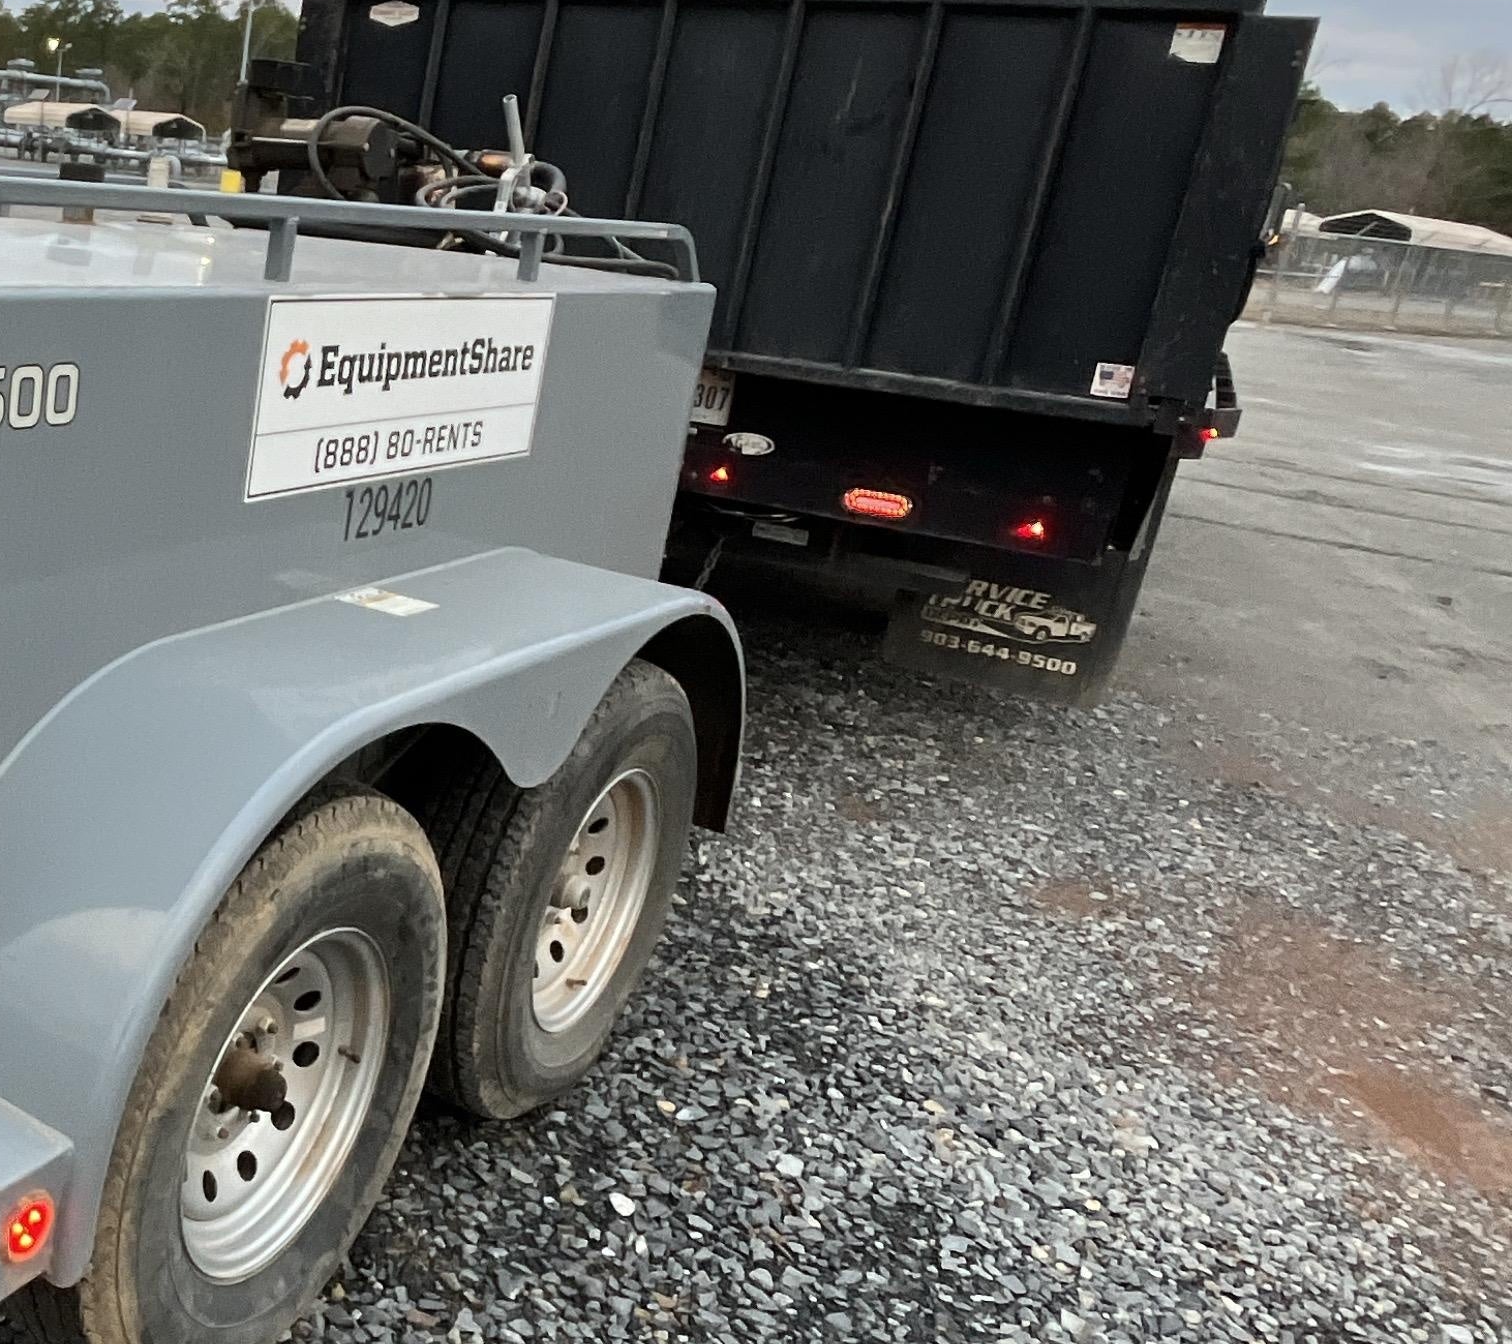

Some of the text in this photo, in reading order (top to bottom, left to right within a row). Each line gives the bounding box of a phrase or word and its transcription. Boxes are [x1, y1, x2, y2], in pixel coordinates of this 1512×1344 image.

[316, 337, 535, 396] EquipmentShare
[314, 420, 484, 474] (888) 80-RENTS
[343, 477, 433, 541] 129420
[965, 578, 1053, 610] RVICE
